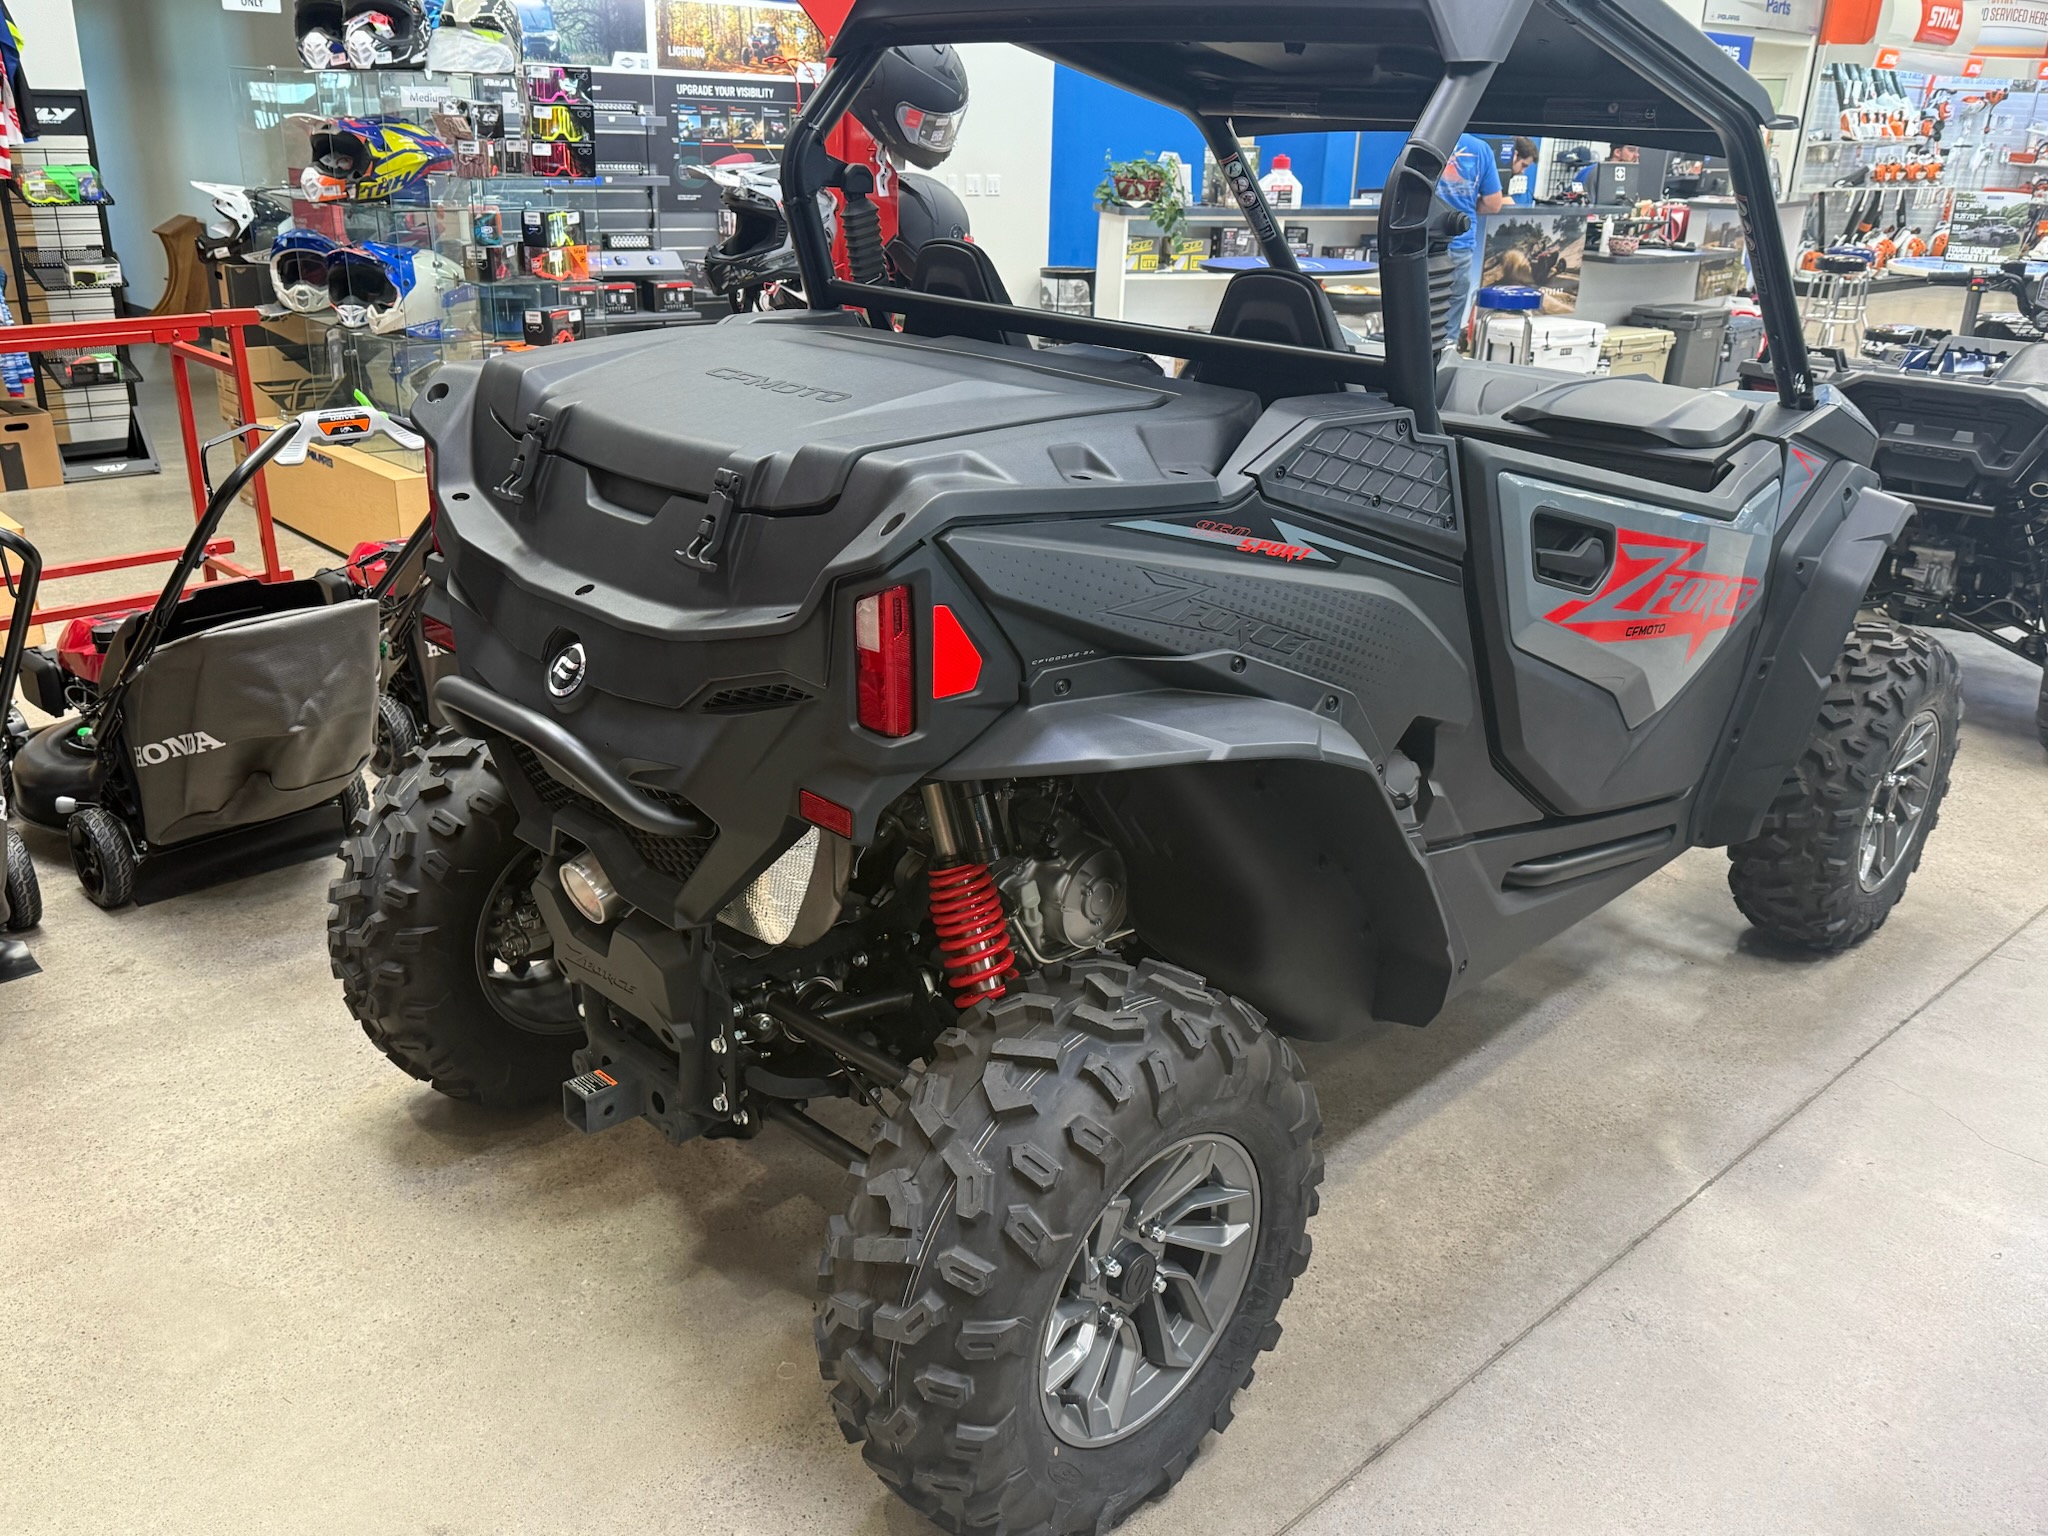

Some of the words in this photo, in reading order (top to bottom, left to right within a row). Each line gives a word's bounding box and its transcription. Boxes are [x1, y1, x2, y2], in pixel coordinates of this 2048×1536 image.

[1765, 0, 1791, 16] Parts
[1927, 5, 1961, 30] STIHL
[1990, 7, 2028, 24] SERVICED
[2030, 10, 2048, 26] HERE
[676, 83, 714, 97] UPGRADE
[714, 85, 736, 98] YOUR
[736, 86, 775, 99] VISIBILITY
[1947, 245, 1970, 254] TOUGH
[705, 367, 852, 403] CFMOTO
[1236, 538, 1316, 562] SPORT
[1625, 623, 1666, 637] CFMOTO
[134, 731, 226, 767] HONDA
